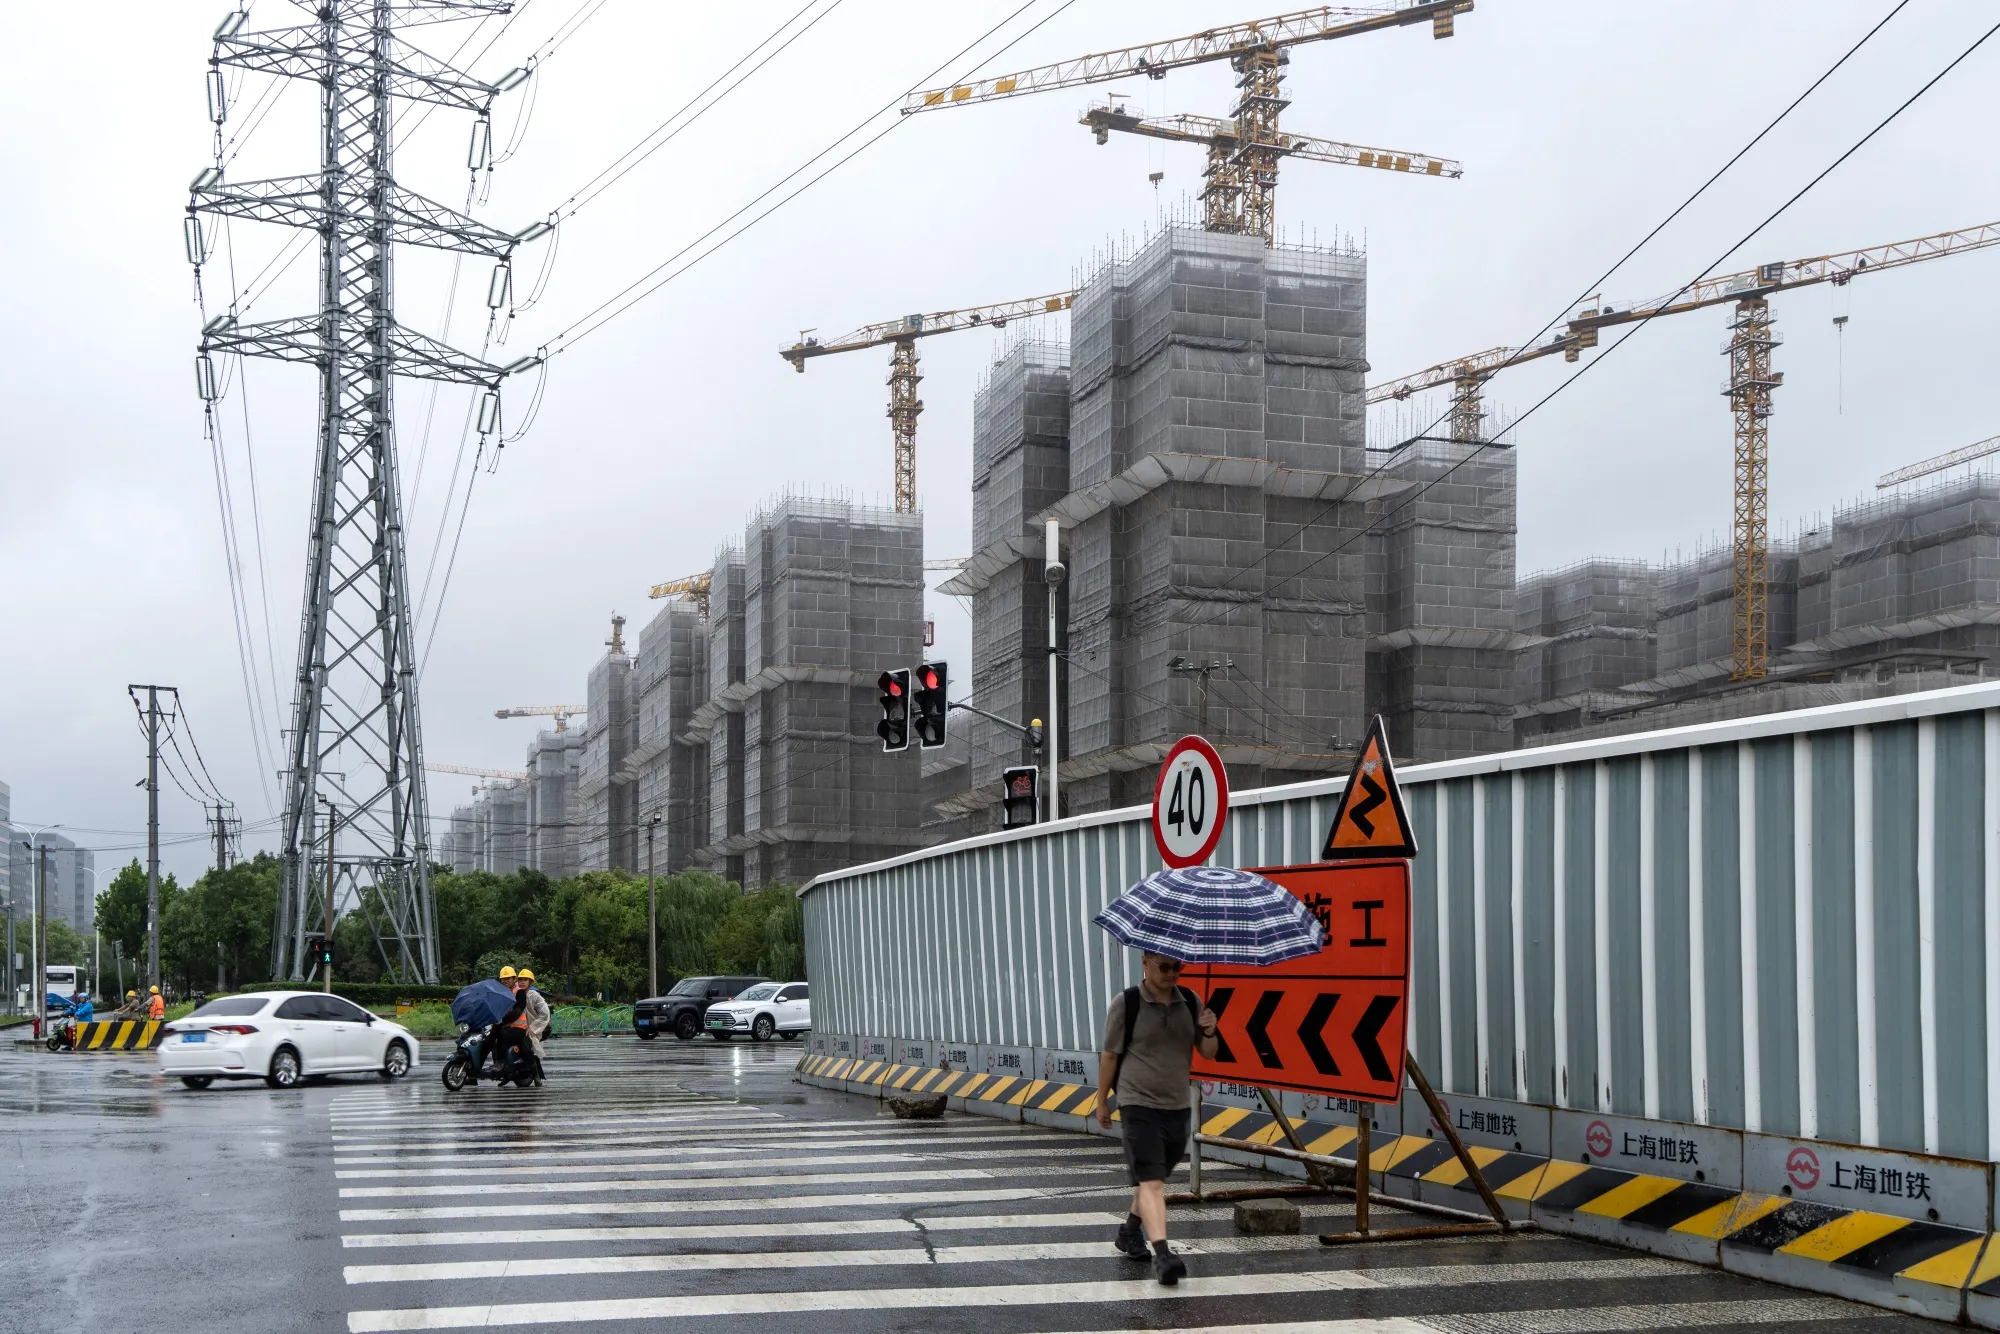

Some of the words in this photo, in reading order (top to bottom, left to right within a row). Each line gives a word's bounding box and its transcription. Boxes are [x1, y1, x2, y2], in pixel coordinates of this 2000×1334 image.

[1167, 766, 1205, 837] 40
[997, 1052, 1021, 1068] 上海地铁
[1057, 1058, 1086, 1075] 上海地铁
[1217, 1081, 1259, 1100] 上海地铁
[1324, 1095, 1358, 1115] 上海地
[1455, 1108, 1518, 1137] 上海地铁
[1619, 1131, 1699, 1165] 上海地铁
[1829, 1160, 1932, 1202] 上海地铁
